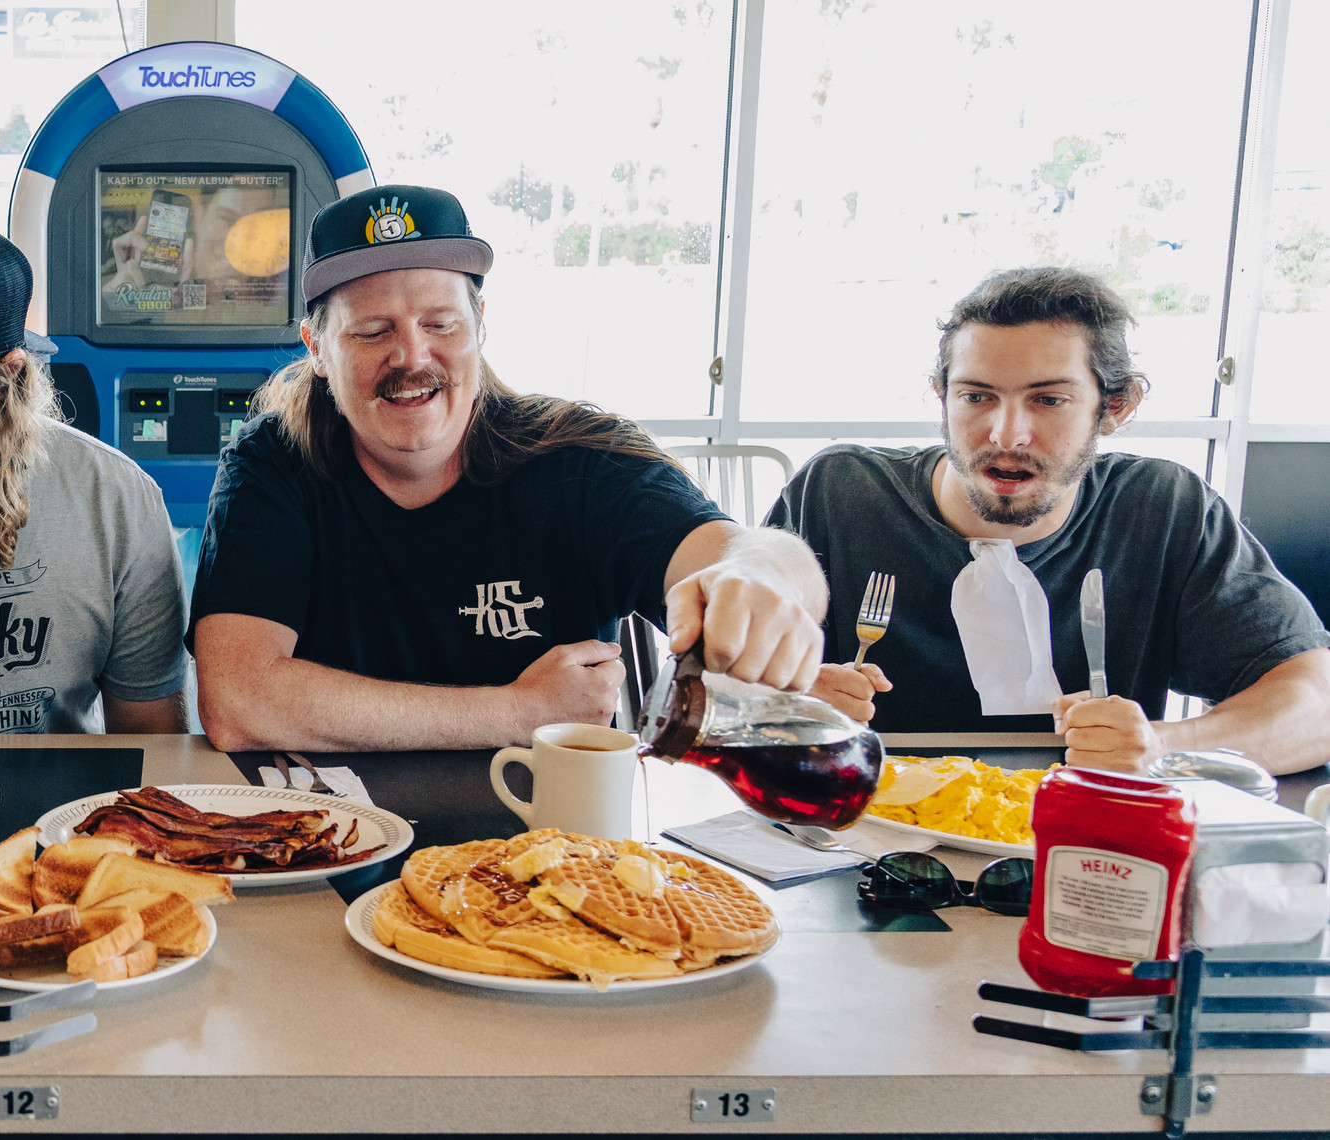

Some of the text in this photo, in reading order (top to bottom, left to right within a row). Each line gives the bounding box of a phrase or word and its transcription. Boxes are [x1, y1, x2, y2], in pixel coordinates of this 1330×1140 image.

[139, 65, 256, 87] TouchTunes
[107, 176, 144, 185] KASH'D
[146, 176, 166, 185] OUT
[174, 176, 197, 185] NEW
[198, 176, 233, 185] ALBUM
[378, 215, 402, 239] 5
[115, 282, 172, 307] Regulars
[1080, 859, 1132, 880] HEINZ
[3, 1090, 34, 1115] 12
[718, 1092, 749, 1117] 13
